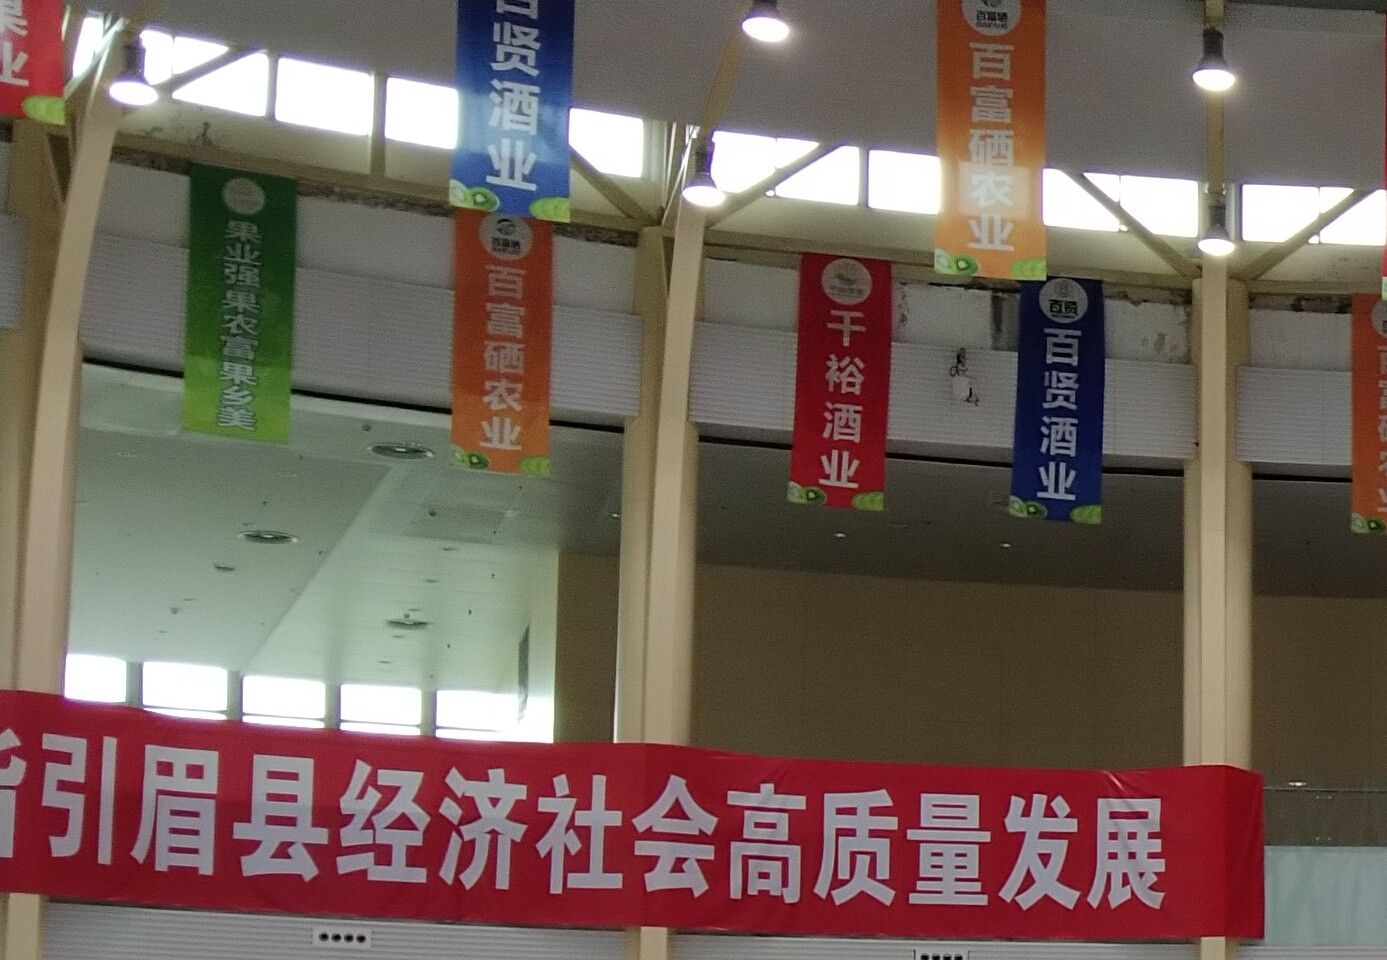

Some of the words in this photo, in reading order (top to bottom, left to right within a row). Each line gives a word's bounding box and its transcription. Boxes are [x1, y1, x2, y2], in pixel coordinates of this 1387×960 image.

[968, 42, 1015, 252] 百富硒农业
[217, 220, 261, 431] 果业强果农富果乡美
[480, 265, 526, 452] 百富硒农业
[1036, 328, 1082, 500] 百贤酒业
